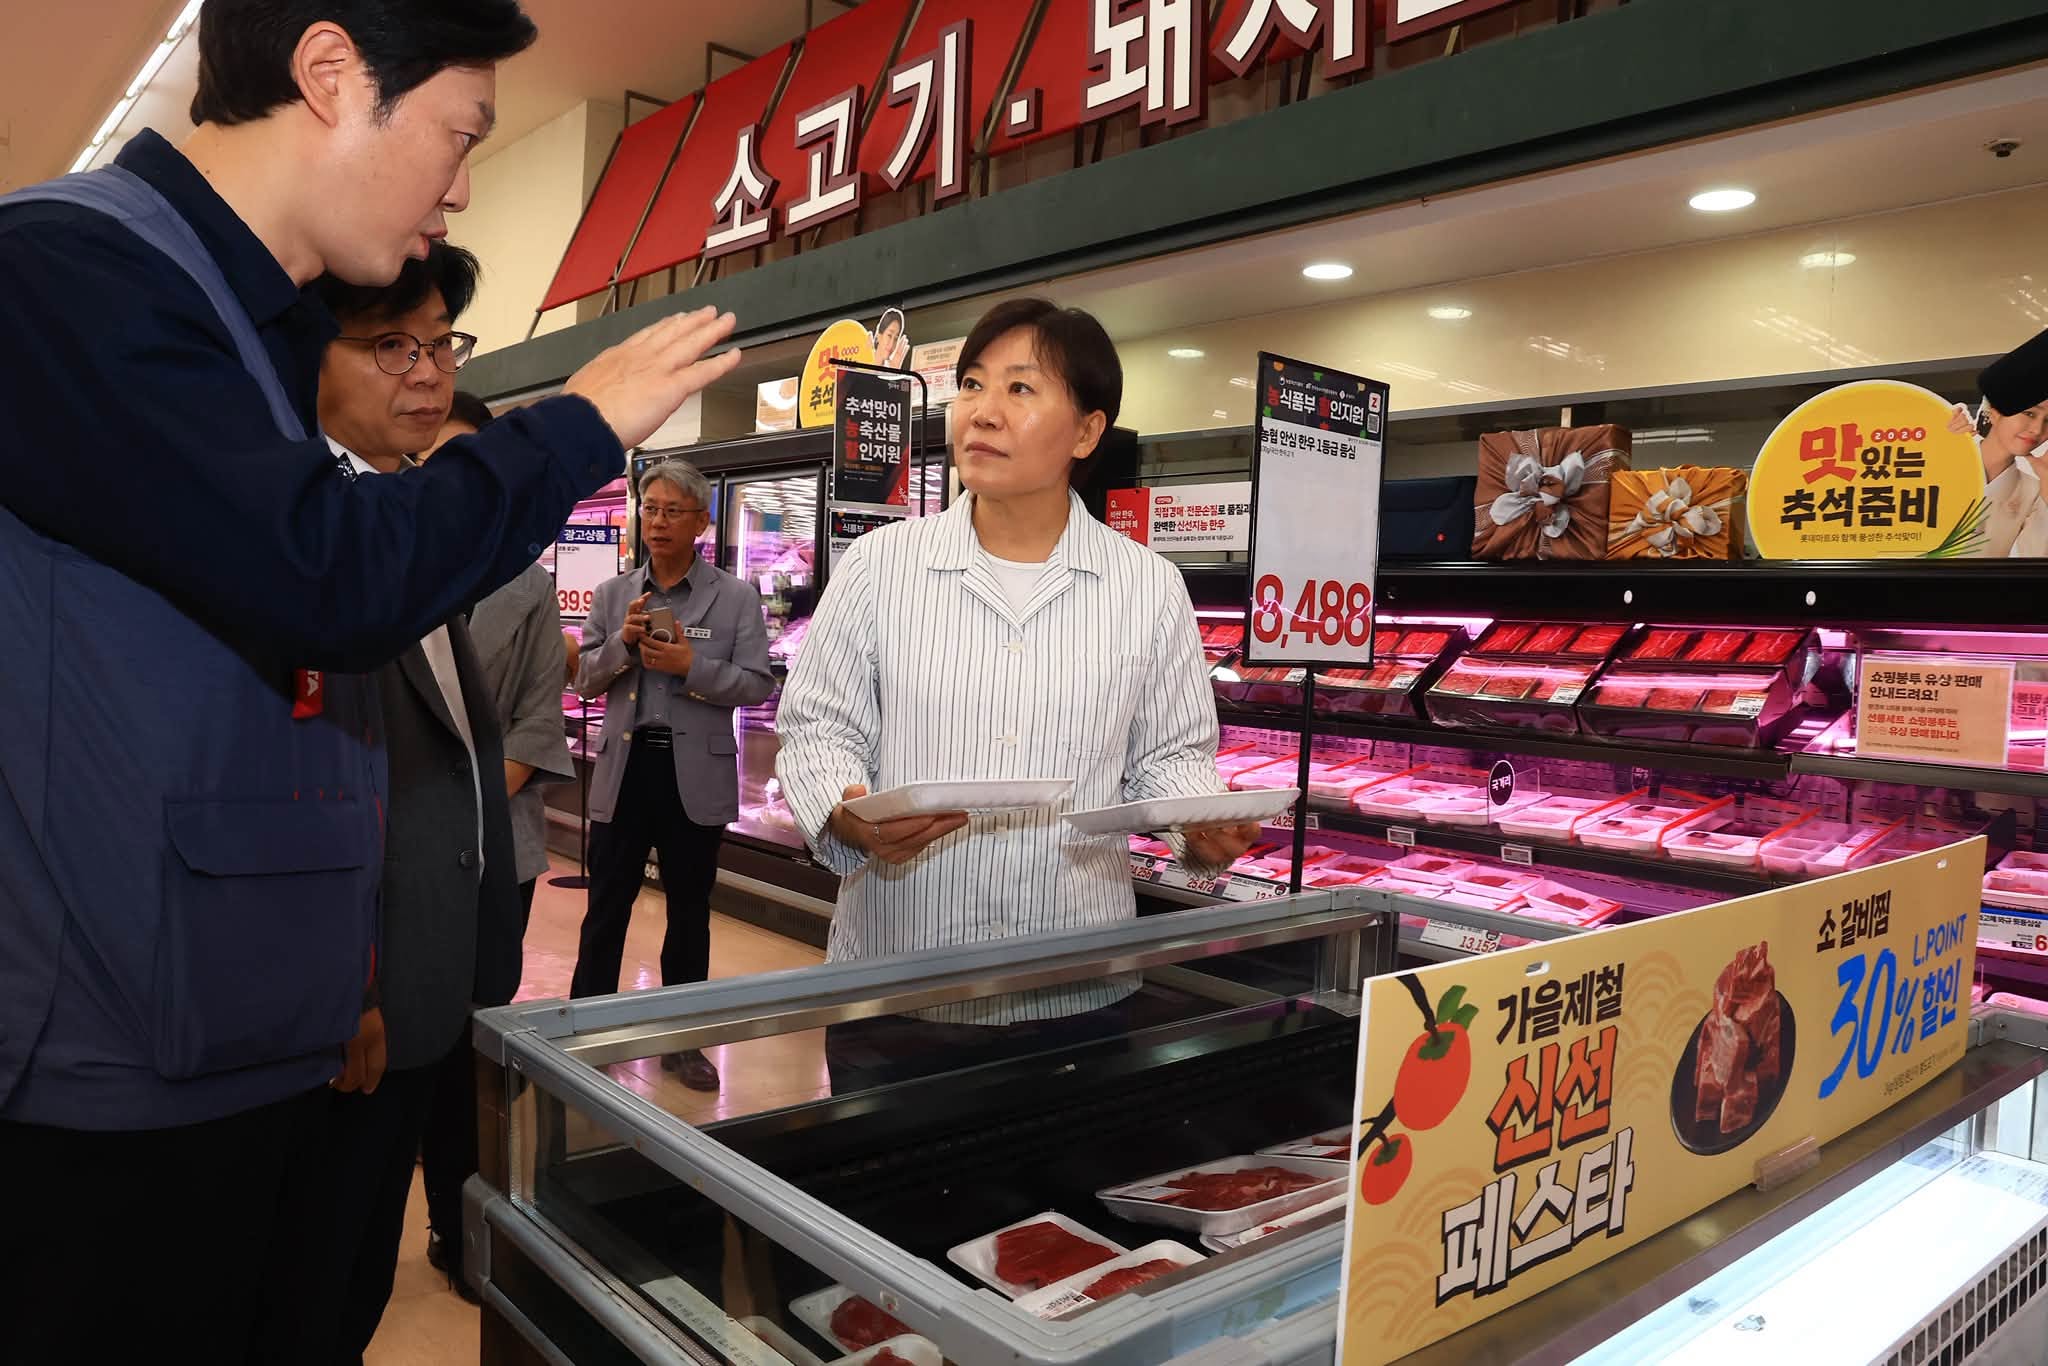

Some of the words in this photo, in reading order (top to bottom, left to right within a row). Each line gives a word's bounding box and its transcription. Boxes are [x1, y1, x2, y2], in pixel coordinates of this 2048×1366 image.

[705, 28, 961, 252] 소고기
[845, 396, 901, 422] 추석맞이
[1268, 385, 1316, 414] 농식품부
[846, 419, 901, 443] 농축산물
[1871, 427, 1926, 443] 2026
[1261, 428, 1278, 445] 농협
[1279, 431, 1297, 448] 안심
[1299, 434, 1316, 452] 한우
[1317, 439, 1338, 456] 1등급
[1340, 445, 1356, 460] 등심
[1799, 423, 1926, 485] 맛있는
[1780, 485, 1940, 530] 추석준비
[563, 529, 606, 541] 광고상품
[1153, 520, 1176, 532] 완벽한
[1176, 519, 1208, 531] 신선지능
[1209, 519, 1226, 531] 한우
[1841, 533, 1858, 543] 함께
[1885, 531, 1922, 541] 추석맞이!
[557, 589, 594, 612] 39,9
[1252, 574, 1373, 649] 8,488
[1870, 670, 1922, 685] 쇼핑봉투
[1924, 674, 1952, 687] 유상
[1954, 675, 1983, 689] 판매
[1869, 686, 1939, 702] 안내드려요!
[1867, 713, 1905, 724] 선물세트
[1908, 716, 1958, 729] 쇼핑봉투는
[1889, 726, 1908, 737] 유상
[1910, 727, 1960, 741] 판매합니다
[1816, 908, 1837, 953] 소
[1840, 889, 1892, 949] 갈비찜
[1459, 936, 1497, 953] 13,152
[1913, 913, 1968, 968] L.POINT
[2035, 934, 2048, 951] 6
[1496, 962, 1625, 1045] 가을제철
[1485, 1025, 1619, 1174] 신선
[1435, 1126, 1635, 1309] 페스타
